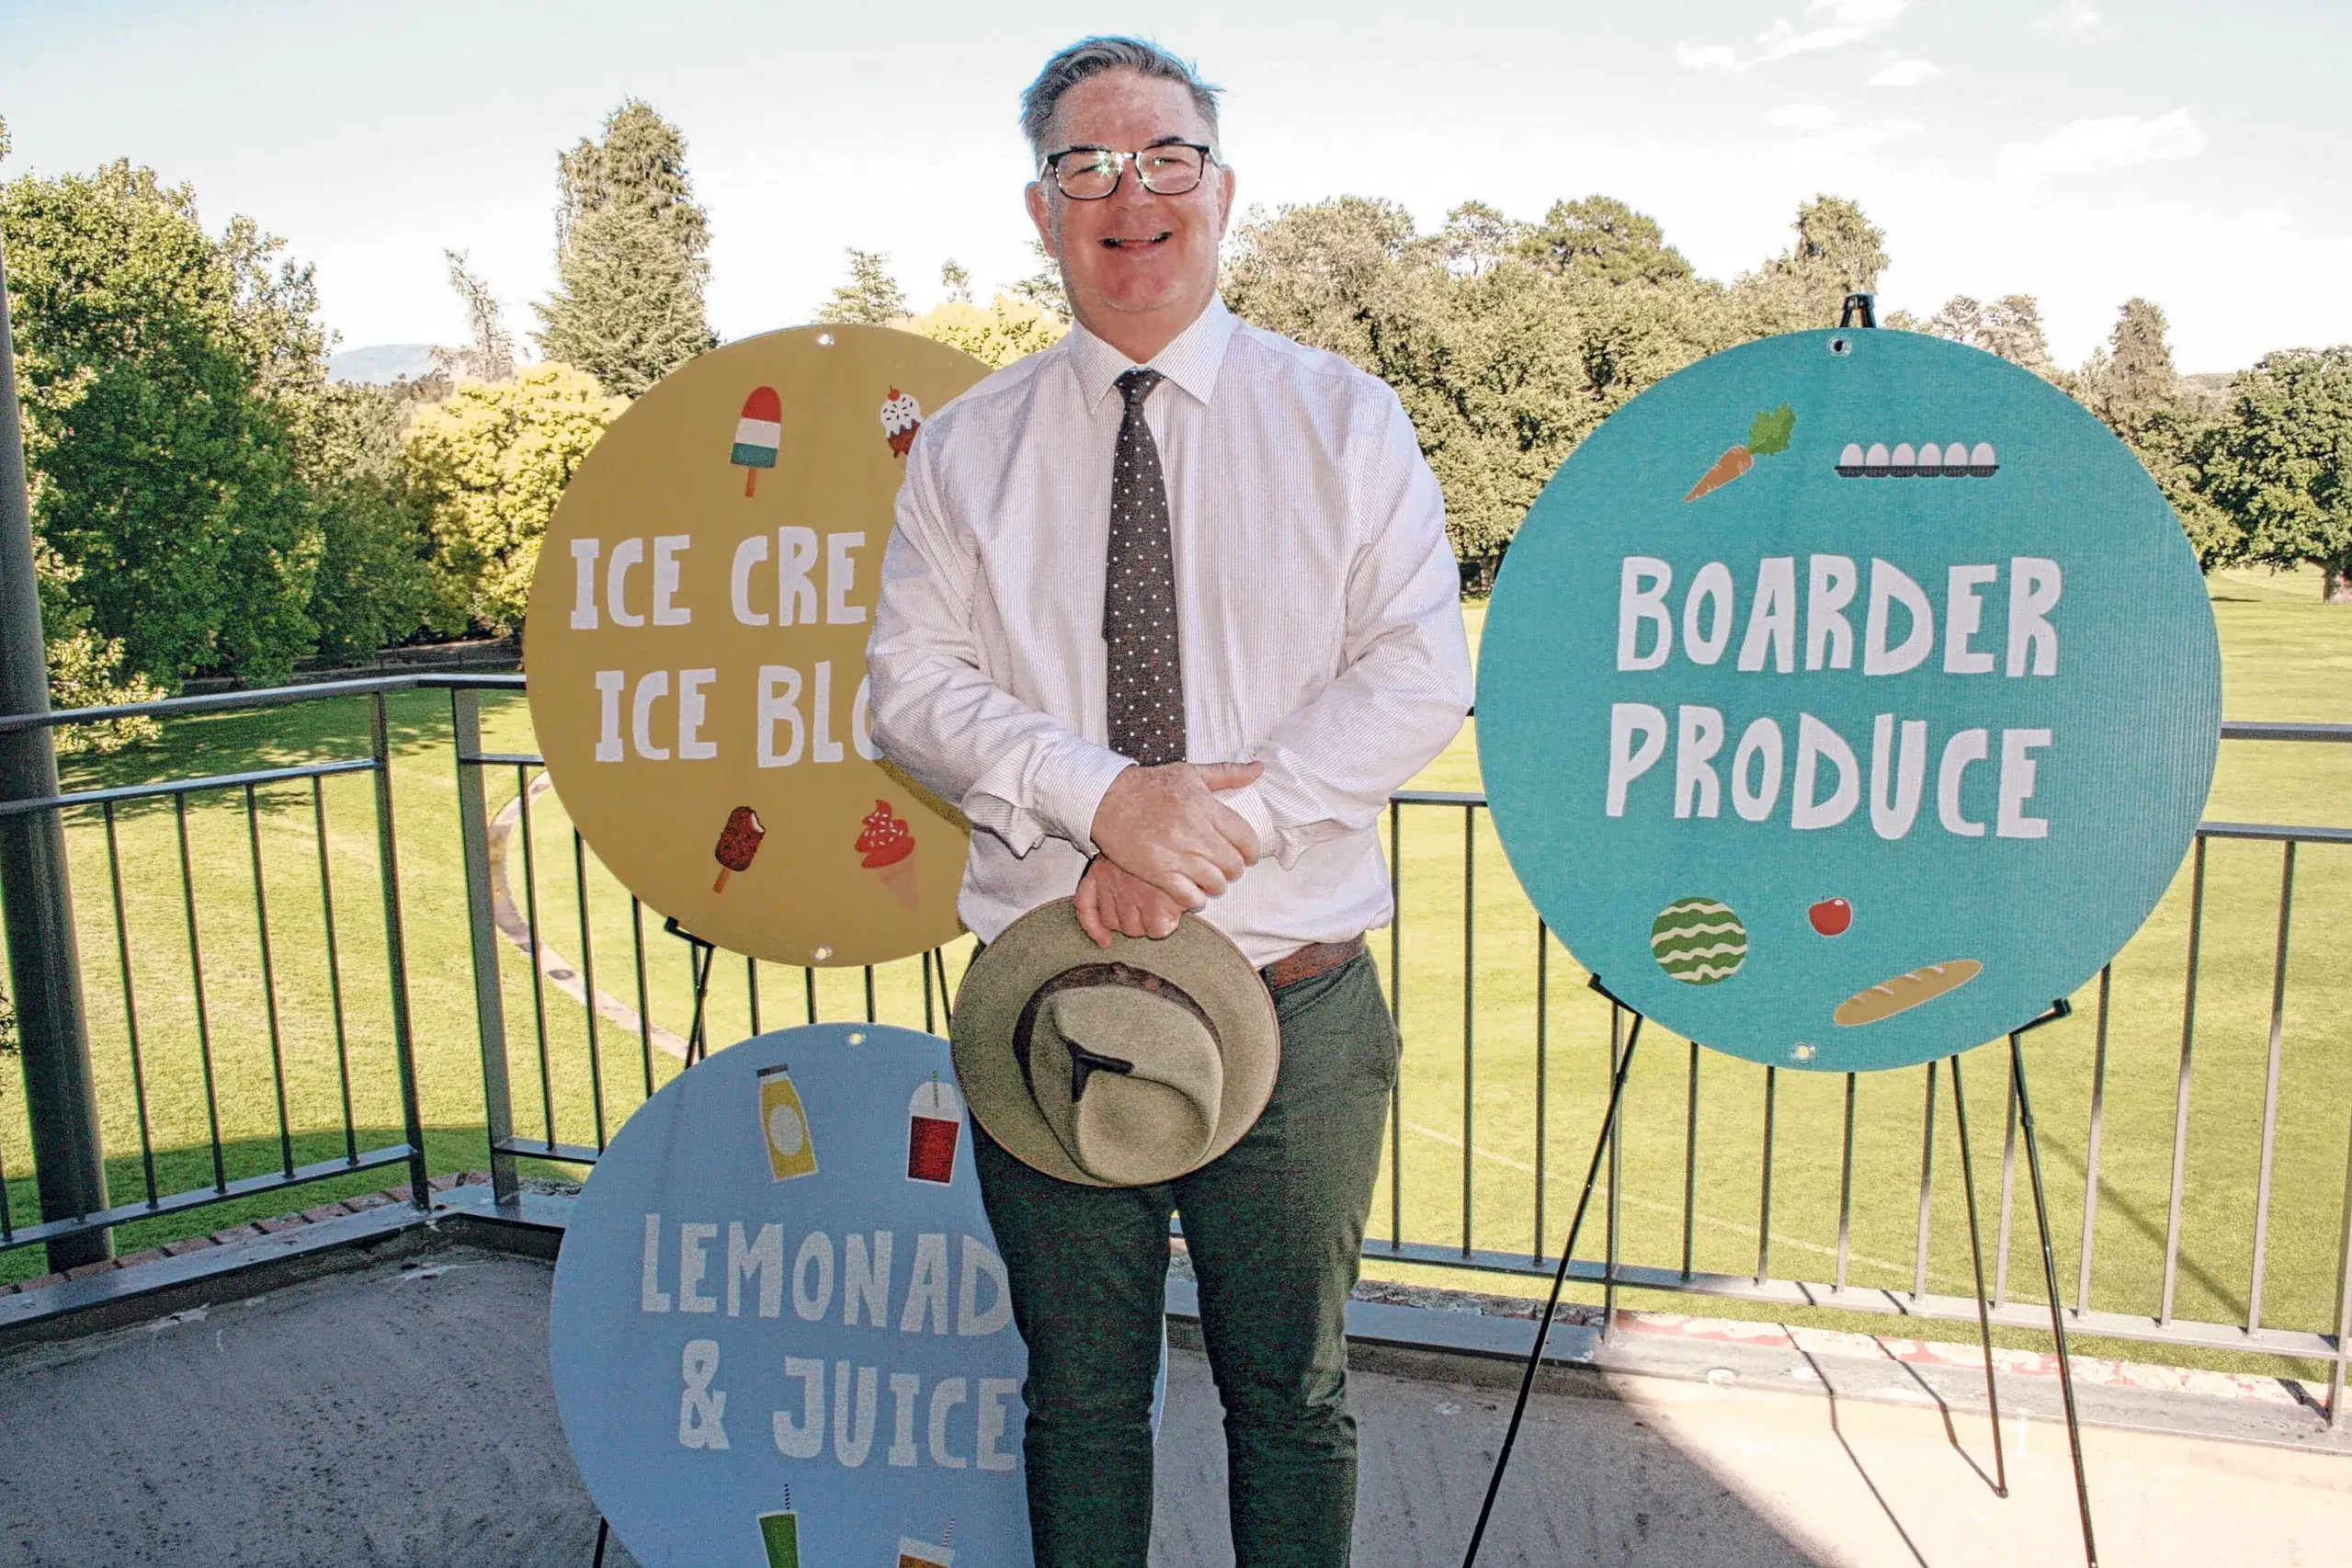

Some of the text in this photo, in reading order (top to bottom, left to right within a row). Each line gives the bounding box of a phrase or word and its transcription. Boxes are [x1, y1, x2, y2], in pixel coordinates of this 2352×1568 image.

[570, 533, 692, 631] ICE
[1615, 553, 2062, 679] BOARDER
[595, 667, 718, 763] ICE
[1605, 701, 2053, 842] PRODUCE
[677, 1338, 1019, 1472] & JUICE
